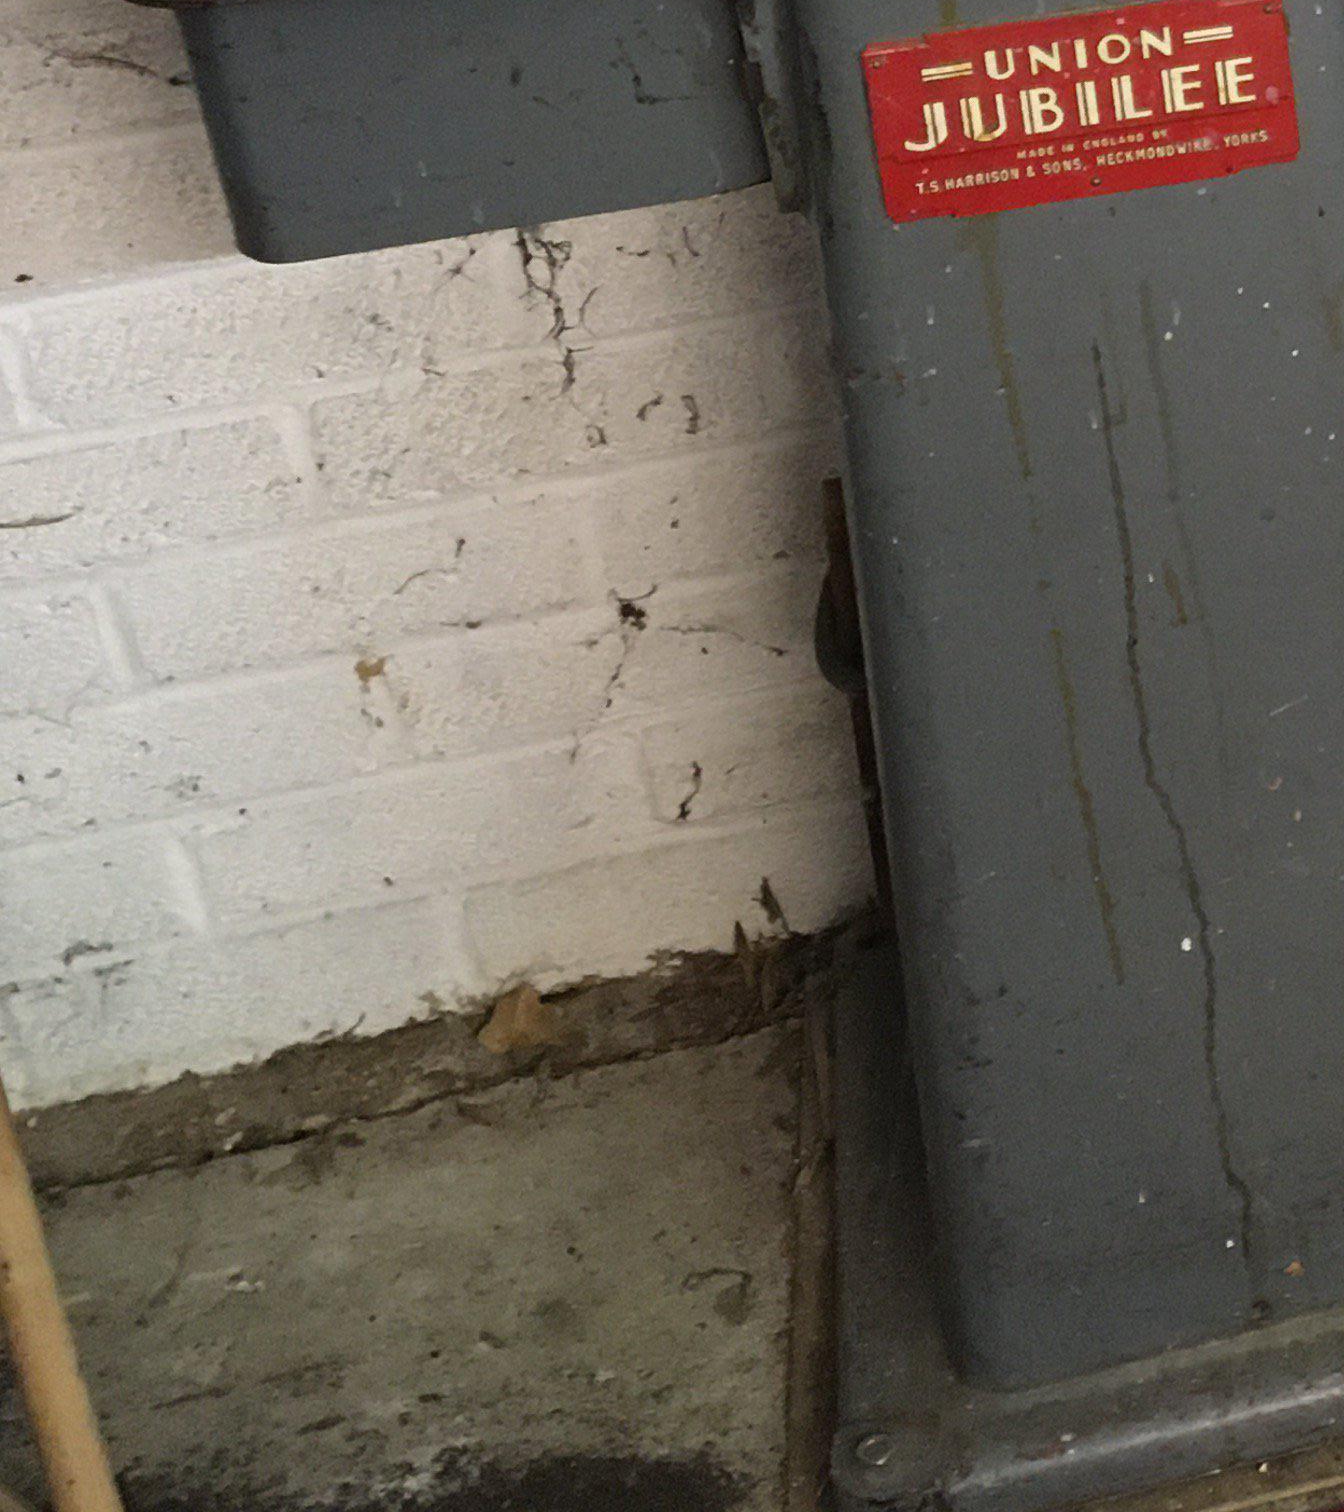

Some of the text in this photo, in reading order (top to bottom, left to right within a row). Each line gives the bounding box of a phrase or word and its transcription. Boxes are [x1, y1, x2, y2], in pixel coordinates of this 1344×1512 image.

[984, 26, 1173, 80] UNION
[904, 56, 1257, 152] JUBILEE
[1016, 145, 1055, 159] MADE
[1061, 143, 1075, 153] IN
[1082, 133, 1145, 150] ENGLAND
[944, 168, 1020, 190] HARRISON
[1026, 165, 1036, 178] &
